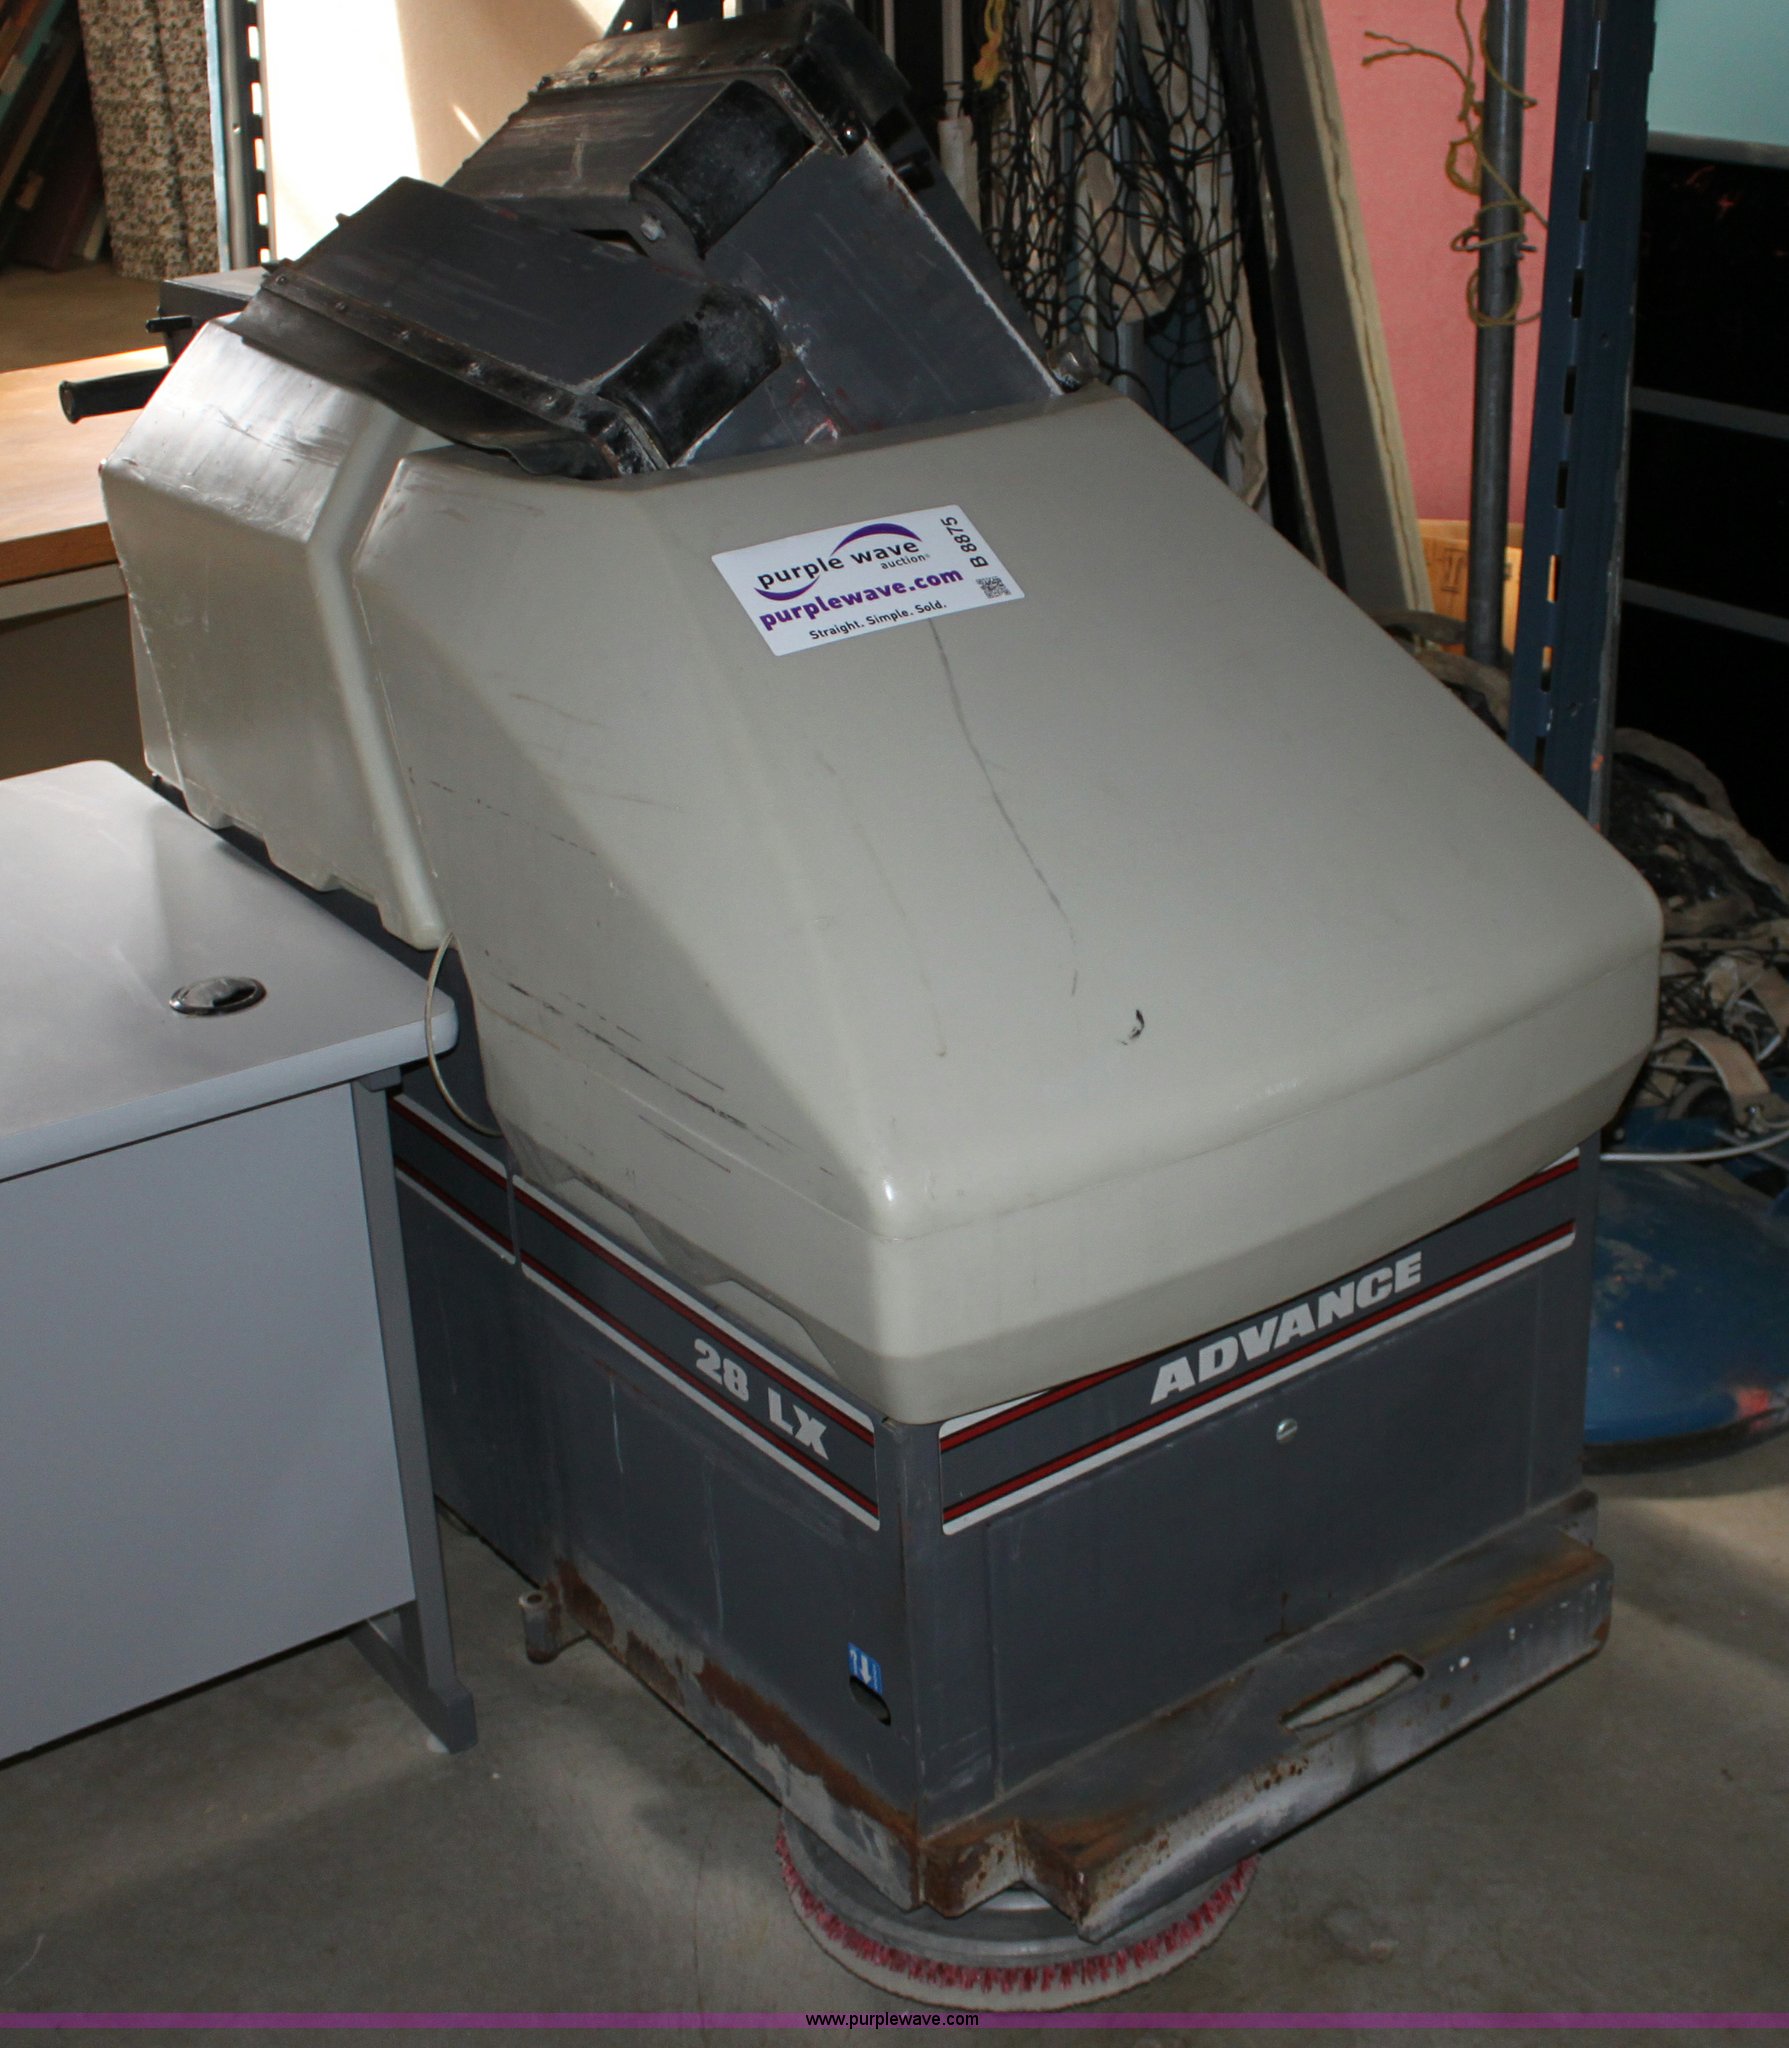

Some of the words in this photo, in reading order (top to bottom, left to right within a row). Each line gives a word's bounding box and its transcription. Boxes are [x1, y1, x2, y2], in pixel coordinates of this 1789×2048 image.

[940, 516, 978, 553] 8875
[757, 556, 844, 590] purple
[850, 540, 920, 565] wave
[971, 555, 989, 569] B
[759, 567, 964, 631] purplewave.com
[809, 620, 864, 640] Straight.
[866, 607, 913, 626] Simple.
[916, 600, 947, 614] Sold.
[1150, 1251, 1422, 1404] ADVANCE
[694, 1338, 750, 1402] 28
[768, 1387, 829, 1460] LX
